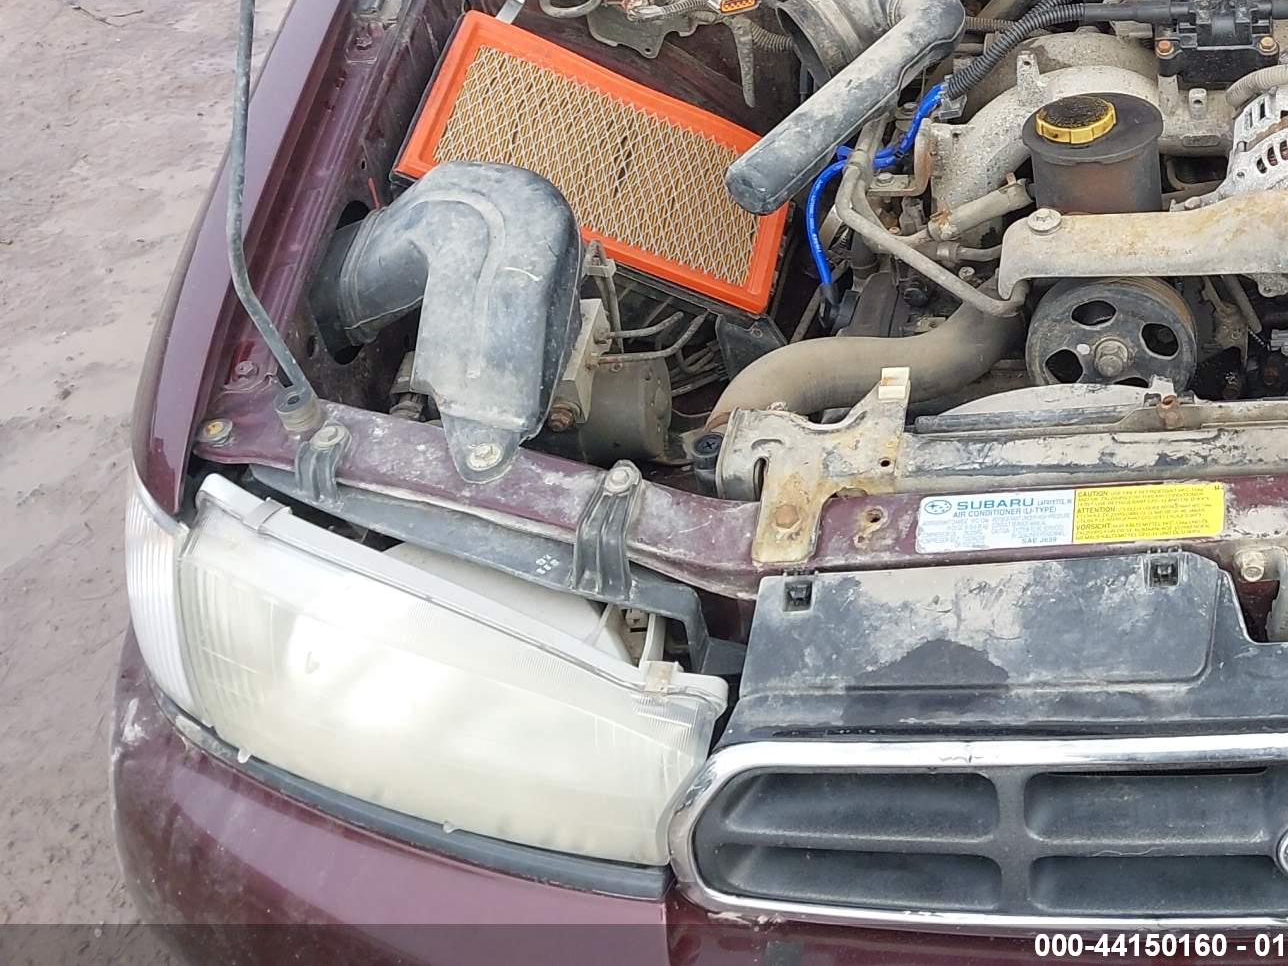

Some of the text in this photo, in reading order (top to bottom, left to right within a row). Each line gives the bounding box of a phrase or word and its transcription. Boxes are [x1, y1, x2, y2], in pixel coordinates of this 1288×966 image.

[1077, 490, 1108, 498] CAUTION
[957, 498, 1034, 510] SUBARU
[968, 508, 1021, 518] CONDITIONER
[1077, 505, 1116, 514] ATTENTION
[1076, 523, 1111, 531] VORSICHT
